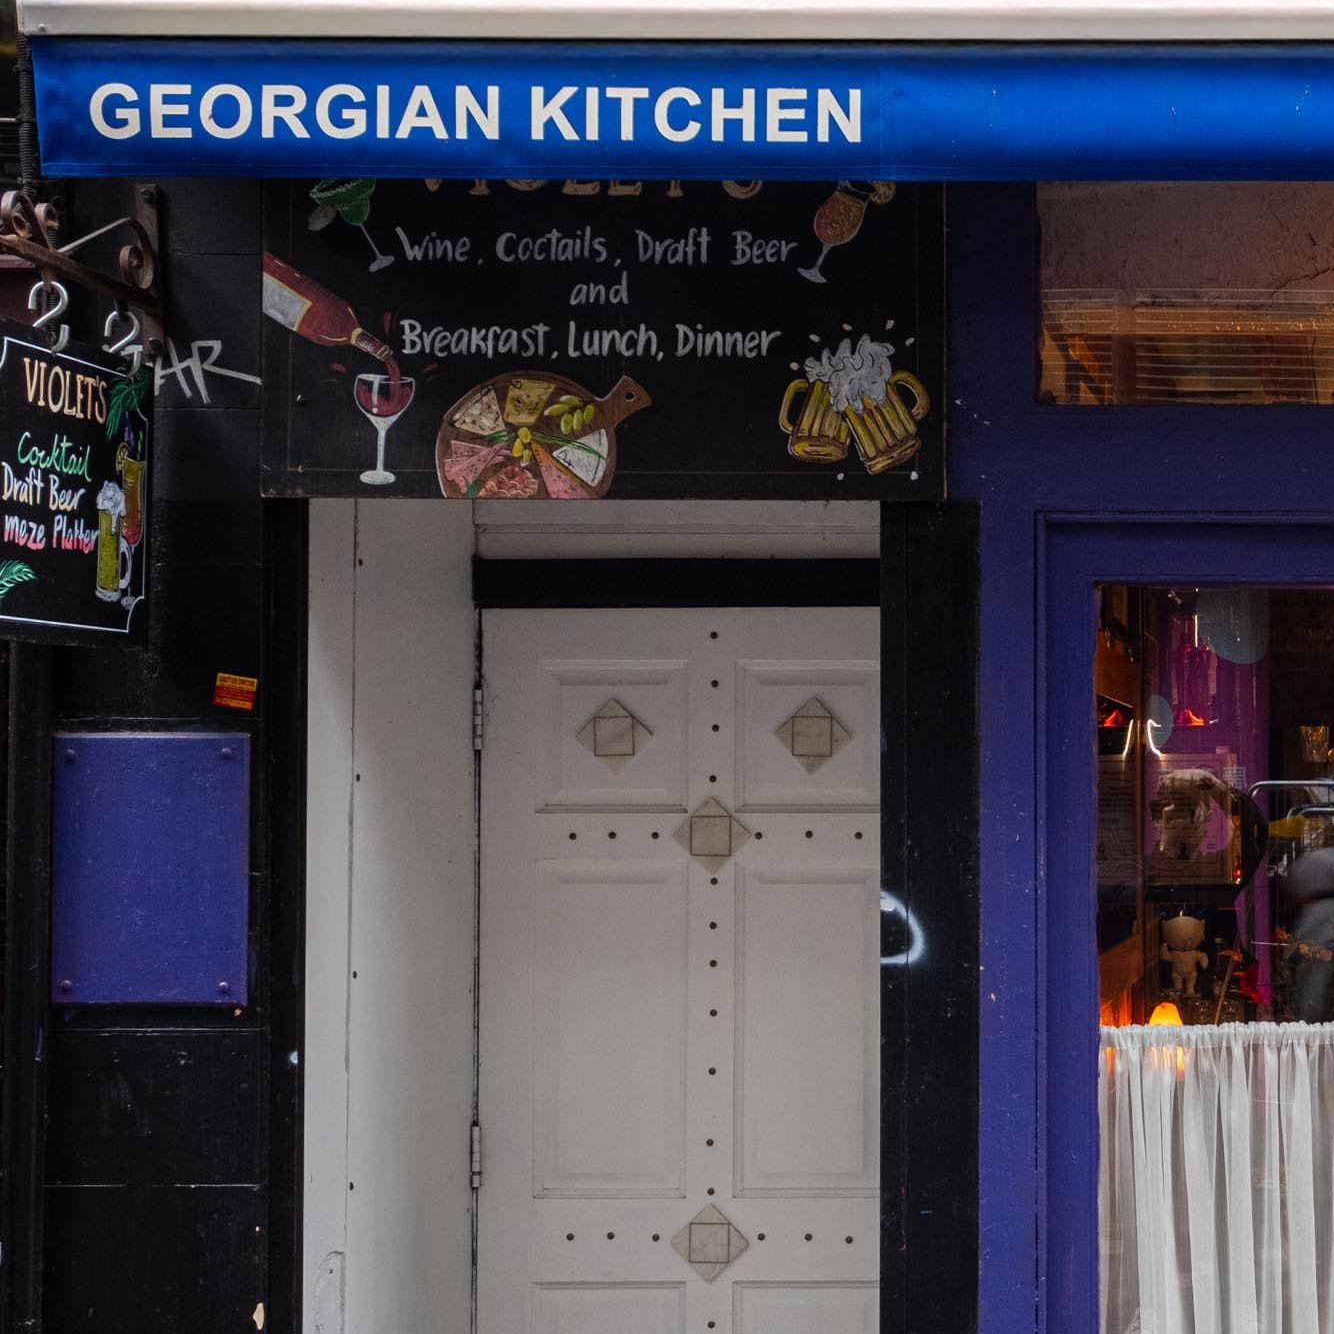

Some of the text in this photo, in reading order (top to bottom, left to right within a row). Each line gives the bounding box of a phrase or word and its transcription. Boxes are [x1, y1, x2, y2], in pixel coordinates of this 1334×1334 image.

[89, 82, 862, 143] GEORGIAN KITCHEN
[634, 226, 713, 265] Draft
[731, 229, 799, 264] Beer
[569, 270, 629, 306] and
[400, 319, 782, 362] Breakfast, Lunch, Dinner
[23, 357, 108, 425] VIOLET'S
[17, 431, 92, 483] Cocktail
[1, 461, 86, 512] Draft Beer
[52, 514, 100, 555] Platter
